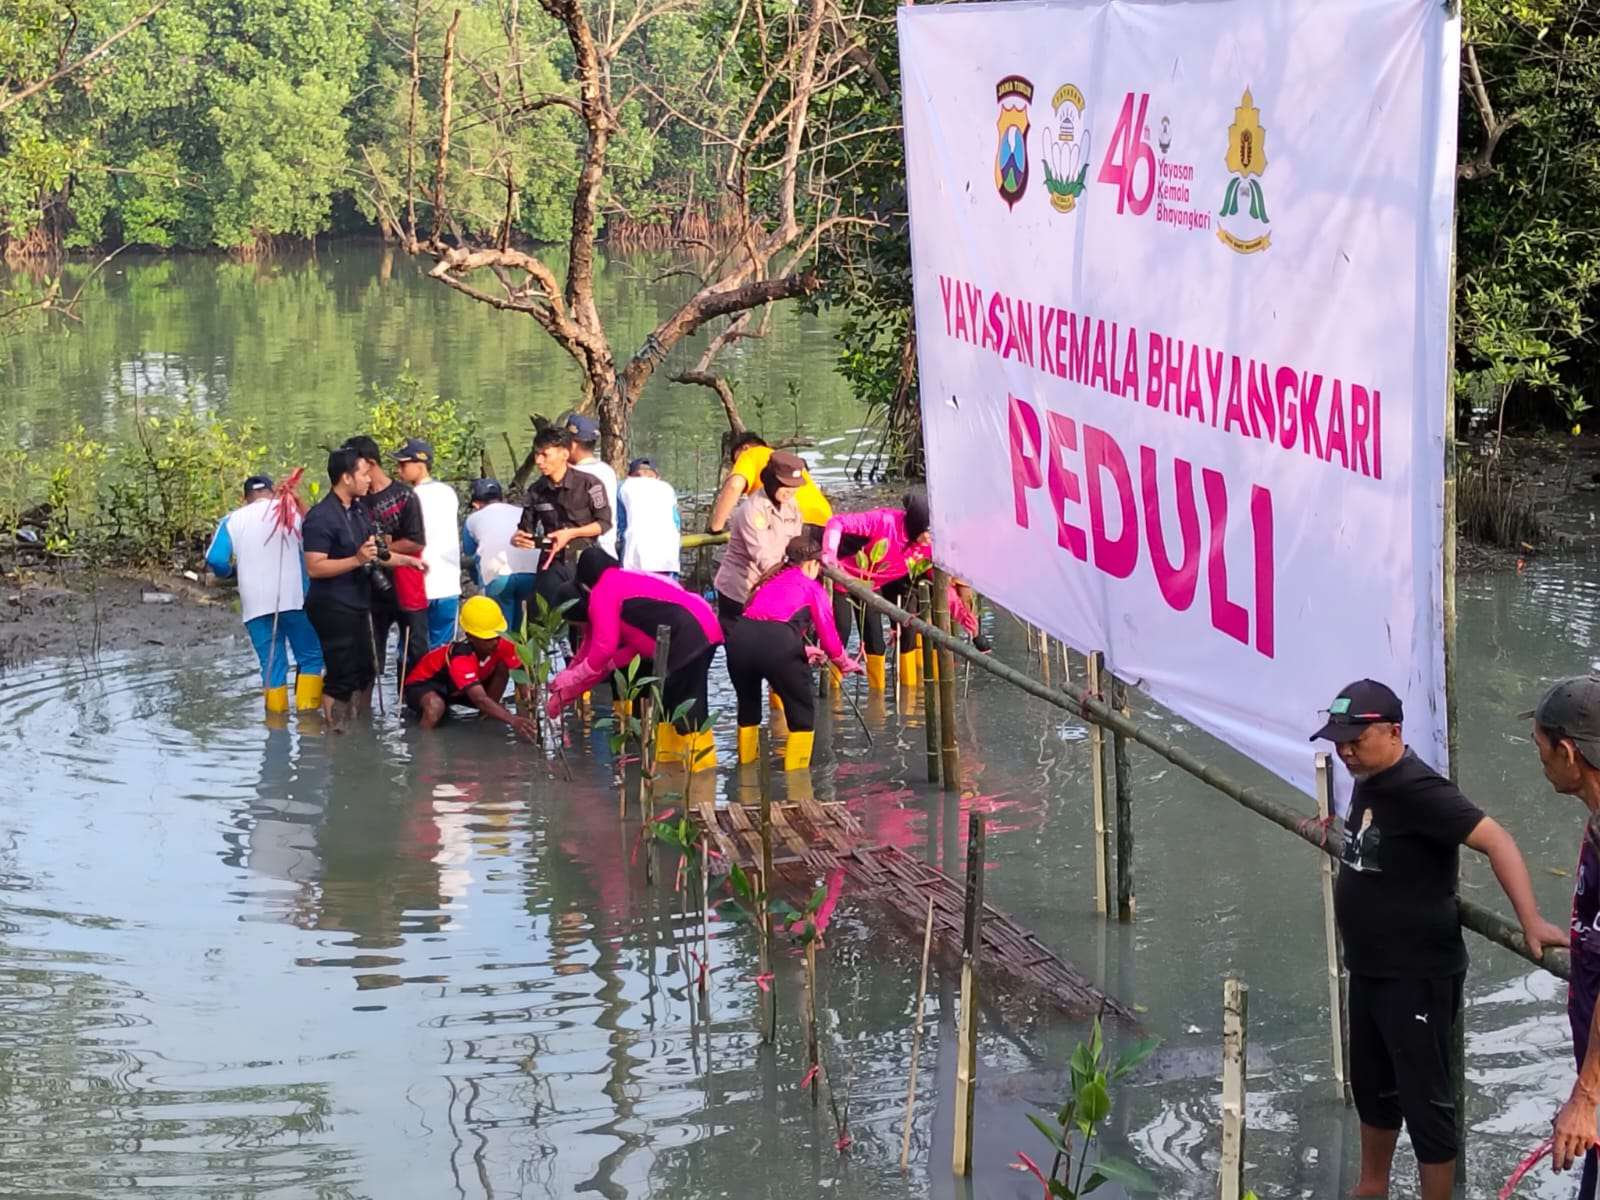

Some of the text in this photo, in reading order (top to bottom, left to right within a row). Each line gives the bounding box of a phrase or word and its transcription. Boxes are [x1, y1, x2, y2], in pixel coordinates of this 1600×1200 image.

[1158, 158, 1194, 182] Yayasan
[1157, 181, 1190, 203] Kemala
[1156, 203, 1211, 230] Bhayangkari
[939, 275, 1382, 480] YAYASAN KEMALA BHAYANGKARI
[1008, 391, 1275, 659] PEDULI
